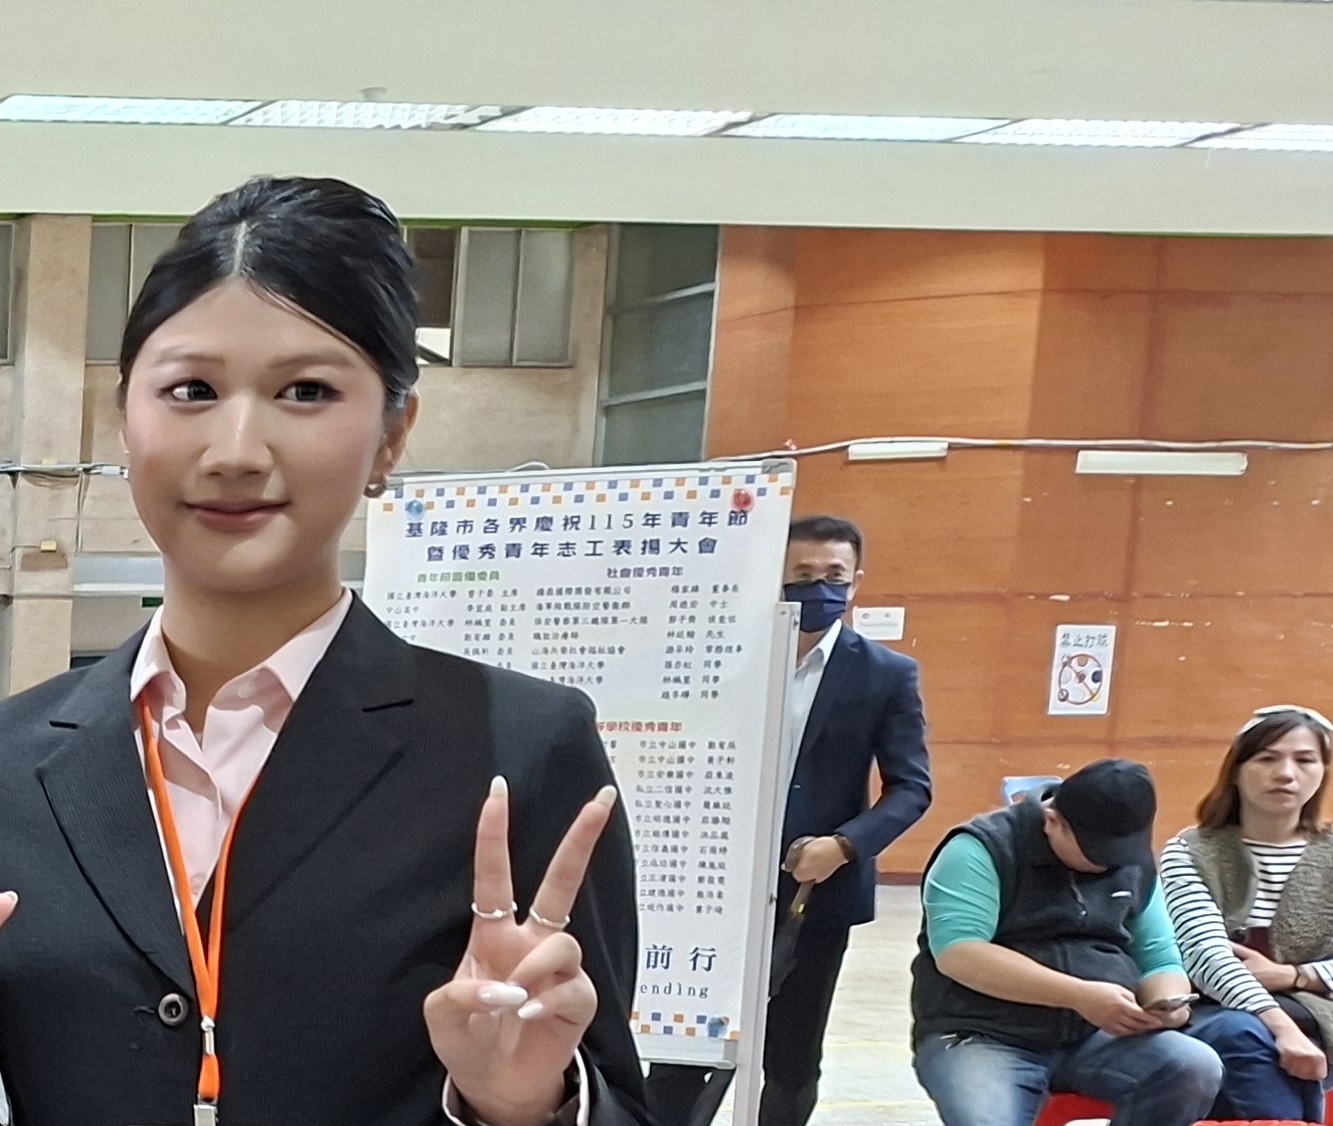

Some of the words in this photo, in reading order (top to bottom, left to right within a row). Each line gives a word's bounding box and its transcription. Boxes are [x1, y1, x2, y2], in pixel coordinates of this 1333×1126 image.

[405, 509, 748, 538] 基隆市各界慶祝115年青年節
[427, 537, 718, 562] 暨優秀青年志工表揚大會
[645, 944, 717, 972] 前行
